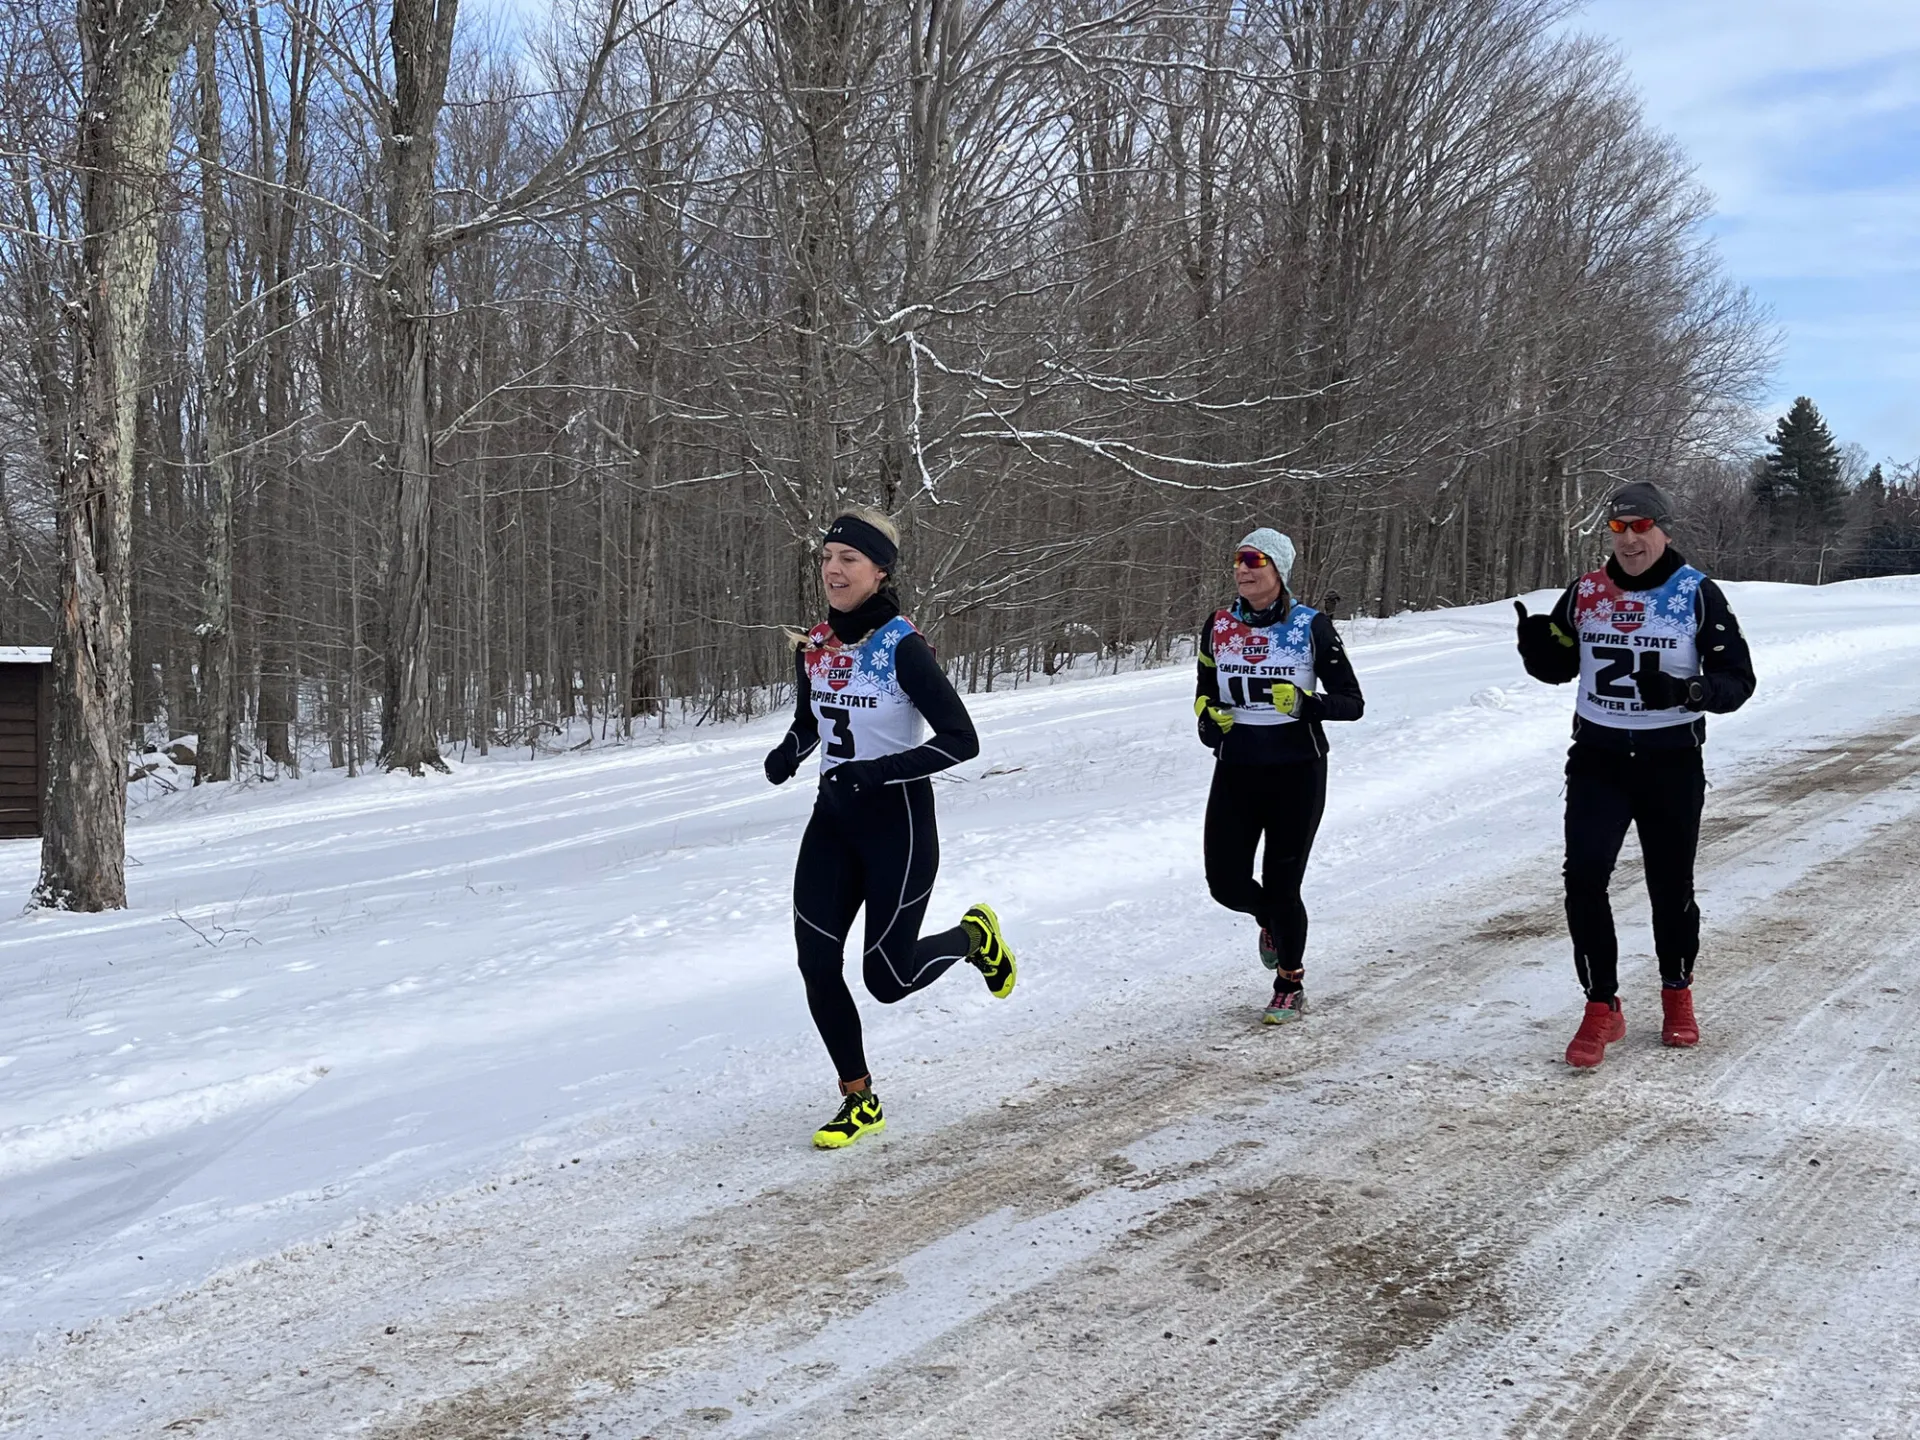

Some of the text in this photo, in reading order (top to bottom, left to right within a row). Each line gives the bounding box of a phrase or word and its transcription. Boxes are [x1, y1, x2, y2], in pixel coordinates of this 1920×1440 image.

[1611, 612, 1646, 622] ESWG
[1582, 632, 1678, 649] EMPIRE STATE
[1242, 646, 1269, 655] ESWG
[828, 669, 853, 679] ESWG
[1219, 663, 1296, 676] EMPIRE STATE
[810, 690, 878, 708] MPIRE STATE
[819, 705, 856, 760] 3
